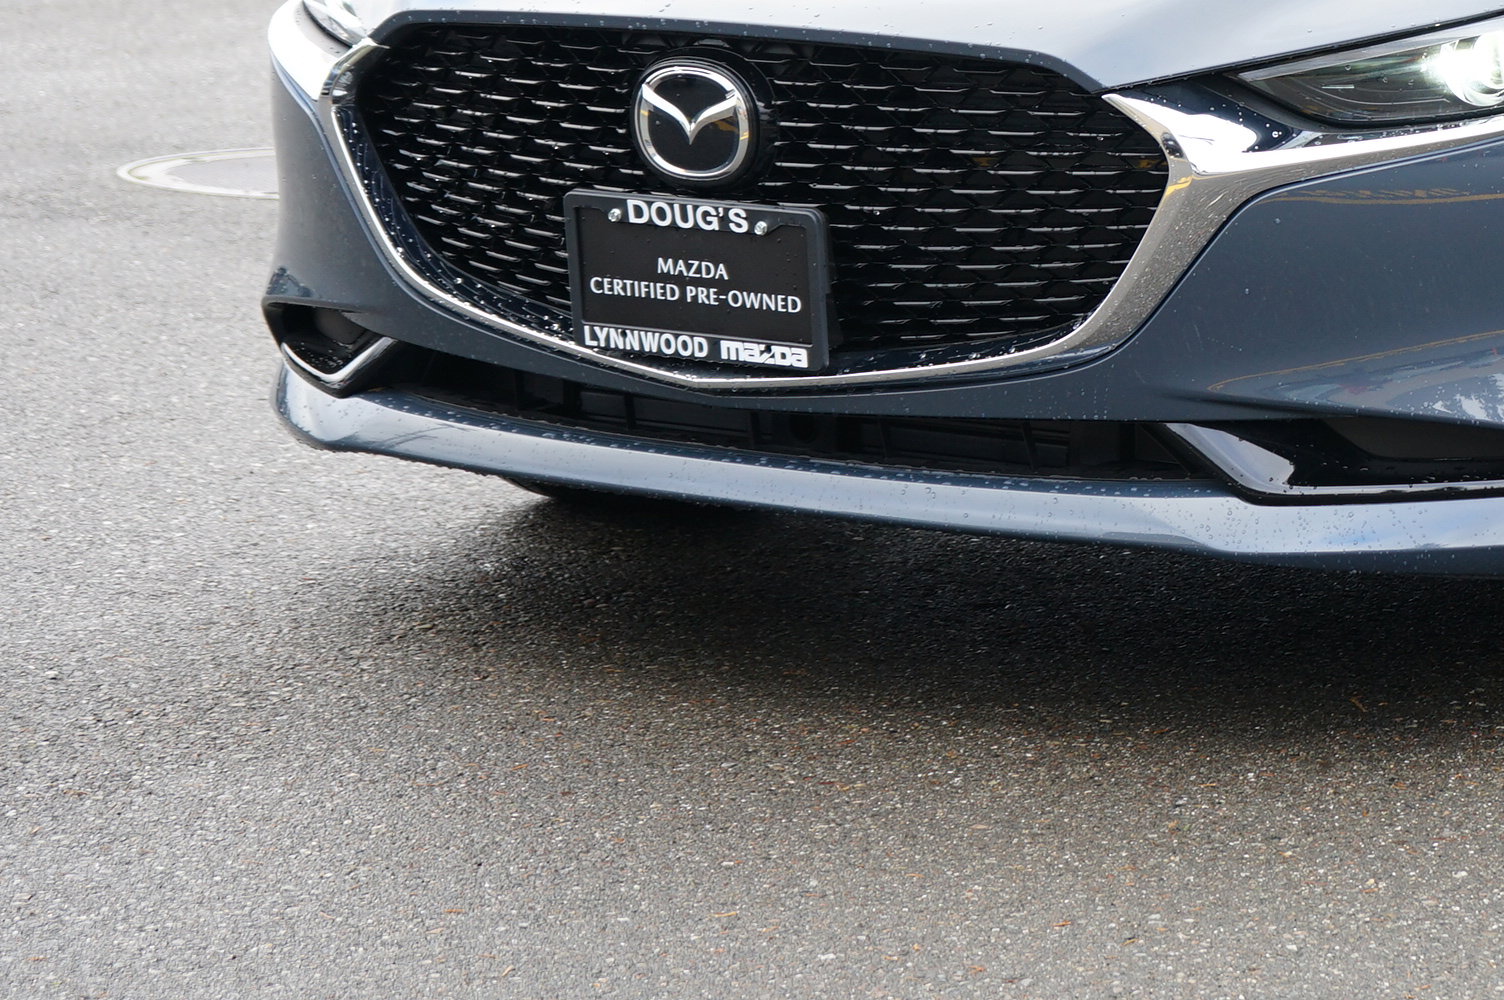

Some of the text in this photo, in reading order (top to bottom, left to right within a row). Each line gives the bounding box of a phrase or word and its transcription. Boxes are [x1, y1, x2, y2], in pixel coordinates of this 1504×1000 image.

[626, 199, 749, 234] DOUG'S
[657, 257, 728, 280] MAZDA
[590, 277, 801, 313] CERTIFIED PRE-OWNED
[583, 325, 708, 358] LYNNWOOD
